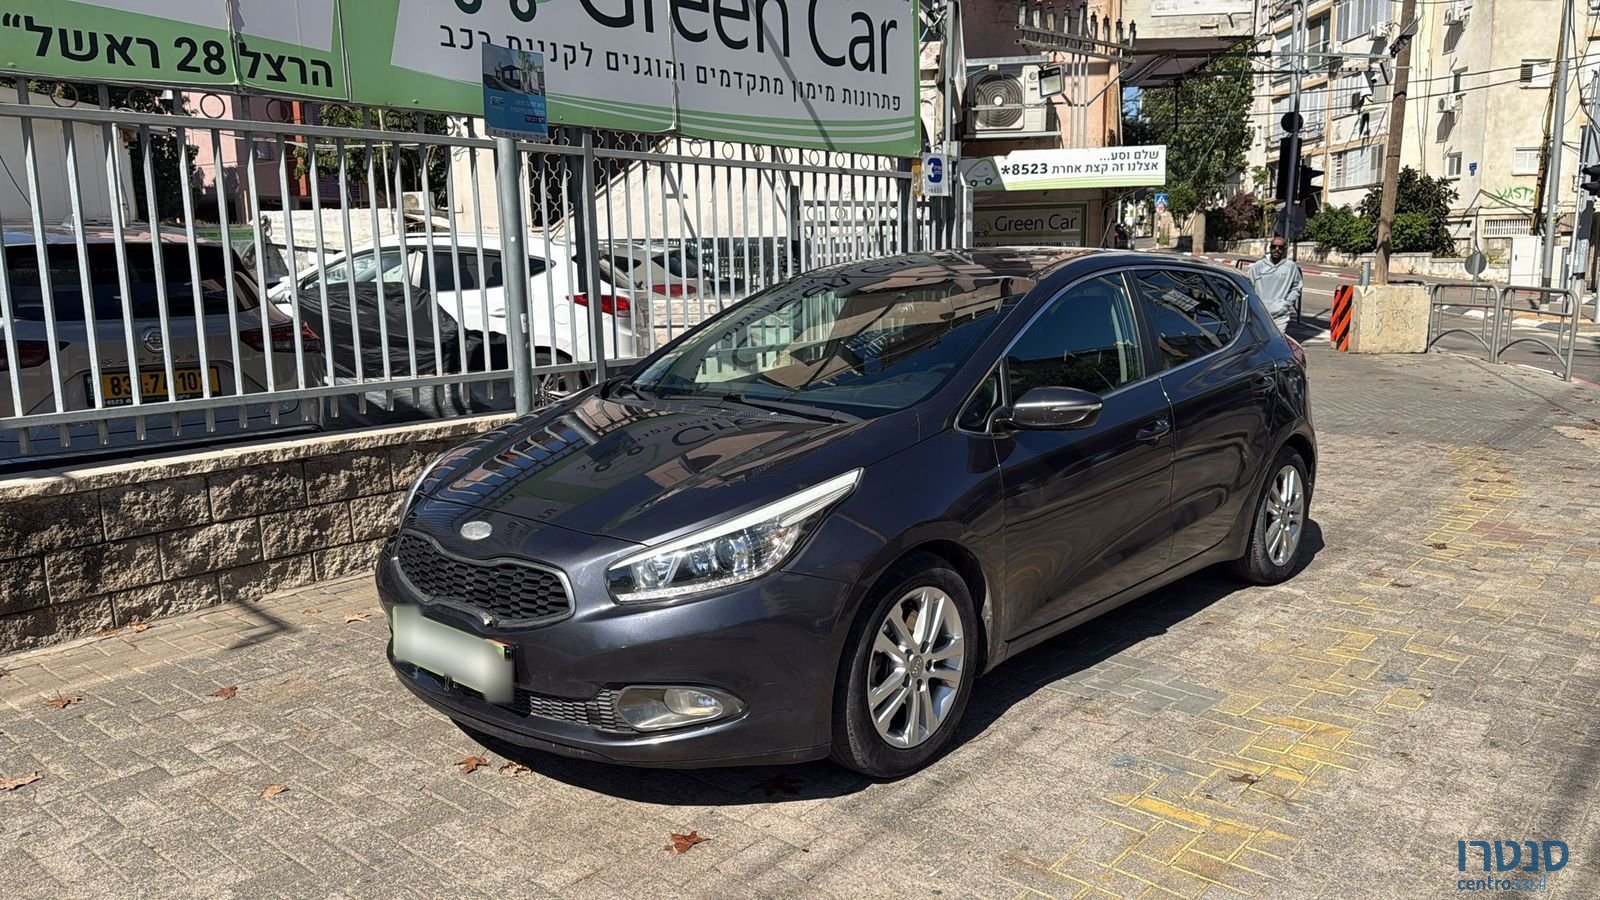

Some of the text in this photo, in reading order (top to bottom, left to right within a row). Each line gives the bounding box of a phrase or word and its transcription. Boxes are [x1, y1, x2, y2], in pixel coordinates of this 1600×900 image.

[808, 0, 898, 75] Car
[173, 37, 227, 75] 28
[239, 41, 333, 88] הרצל
[606, 51, 685, 82] והוגנים
[696, 65, 784, 96] מתקדמים
[792, 80, 835, 103] מימון
[842, 88, 901, 111] פתרונות
[1127, 160, 1158, 171] אצלנו
[1134, 149, 1159, 160] שלם
[1052, 164, 1082, 174] אחרת
[1085, 164, 1108, 174] קצת
[1112, 163, 1123, 172] זה
[994, 214, 1077, 232] Green Car
